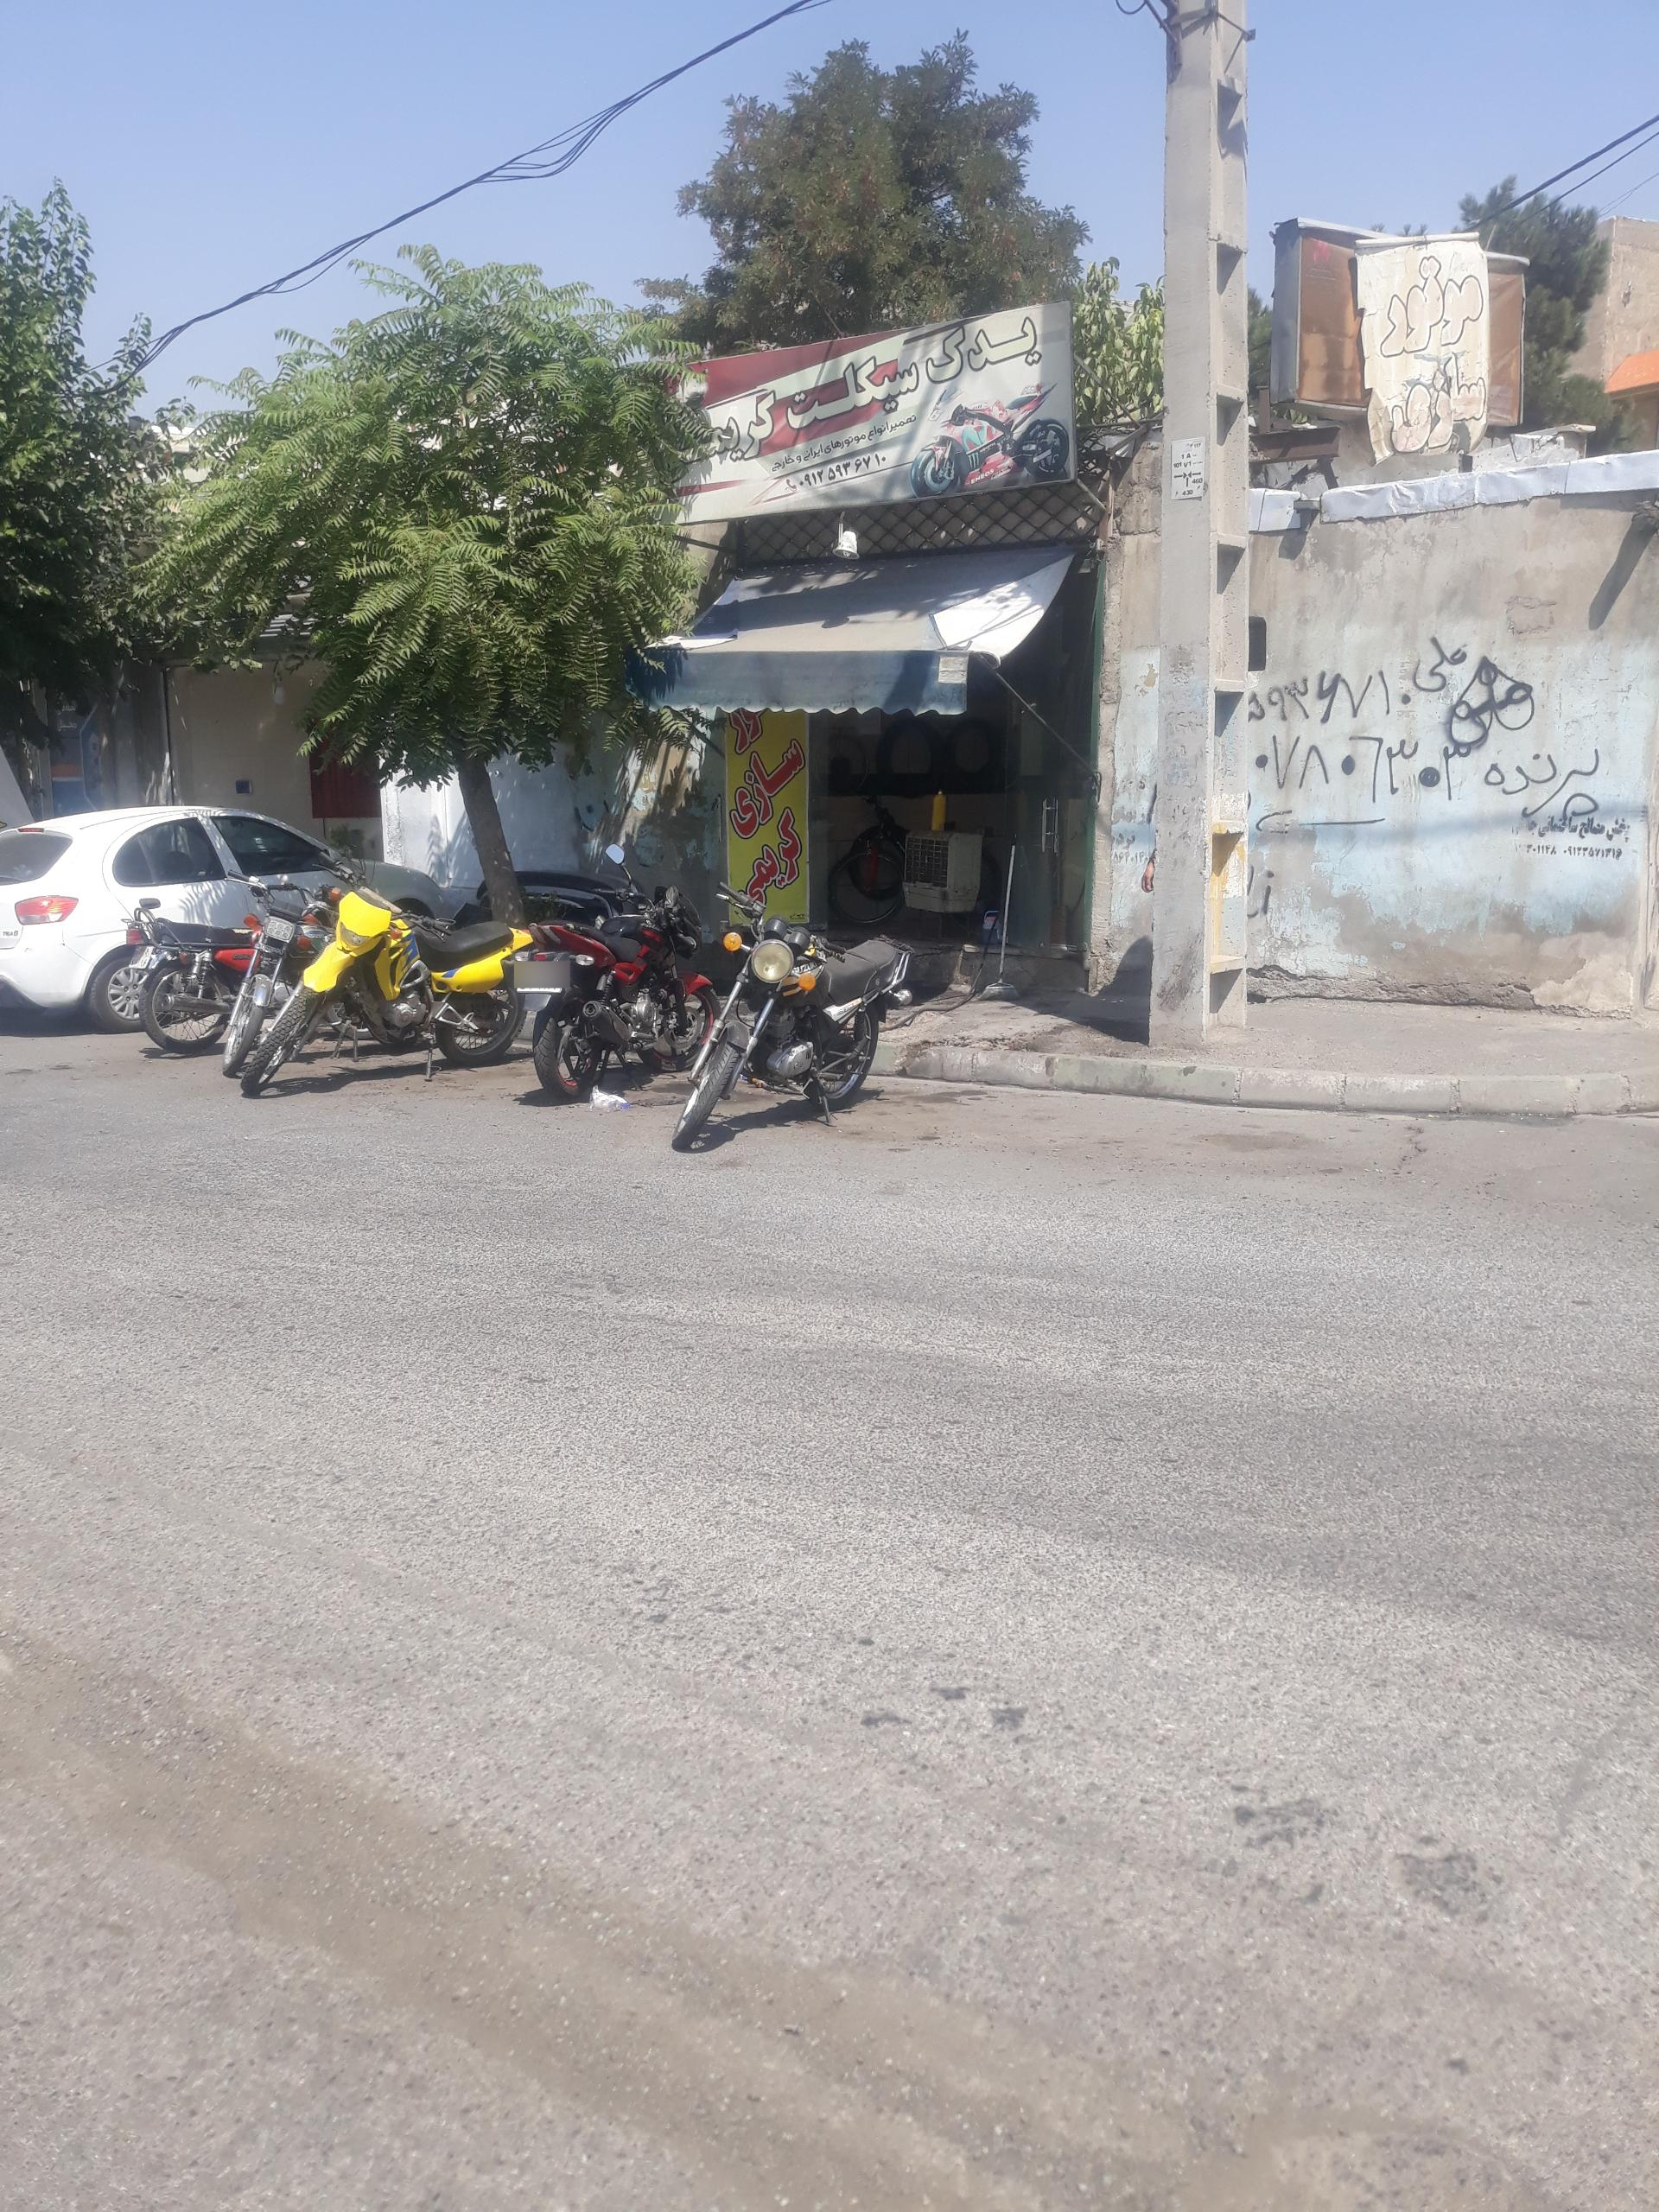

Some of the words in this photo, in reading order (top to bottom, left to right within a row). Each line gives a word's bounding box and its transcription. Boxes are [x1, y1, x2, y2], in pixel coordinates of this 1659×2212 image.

[926, 316, 1042, 383] یدک
[787, 356, 919, 430] سیکلت
[867, 421, 889, 442] انواع
[889, 414, 917, 433] تعمیر
[823, 433, 867, 454] موتورهای
[798, 470, 824, 487] ۰۹۱۲
[827, 461, 851, 481] ۵۹۳
[970, 468, 995, 485] ENEOS
[730, 738, 805, 839] سازی
